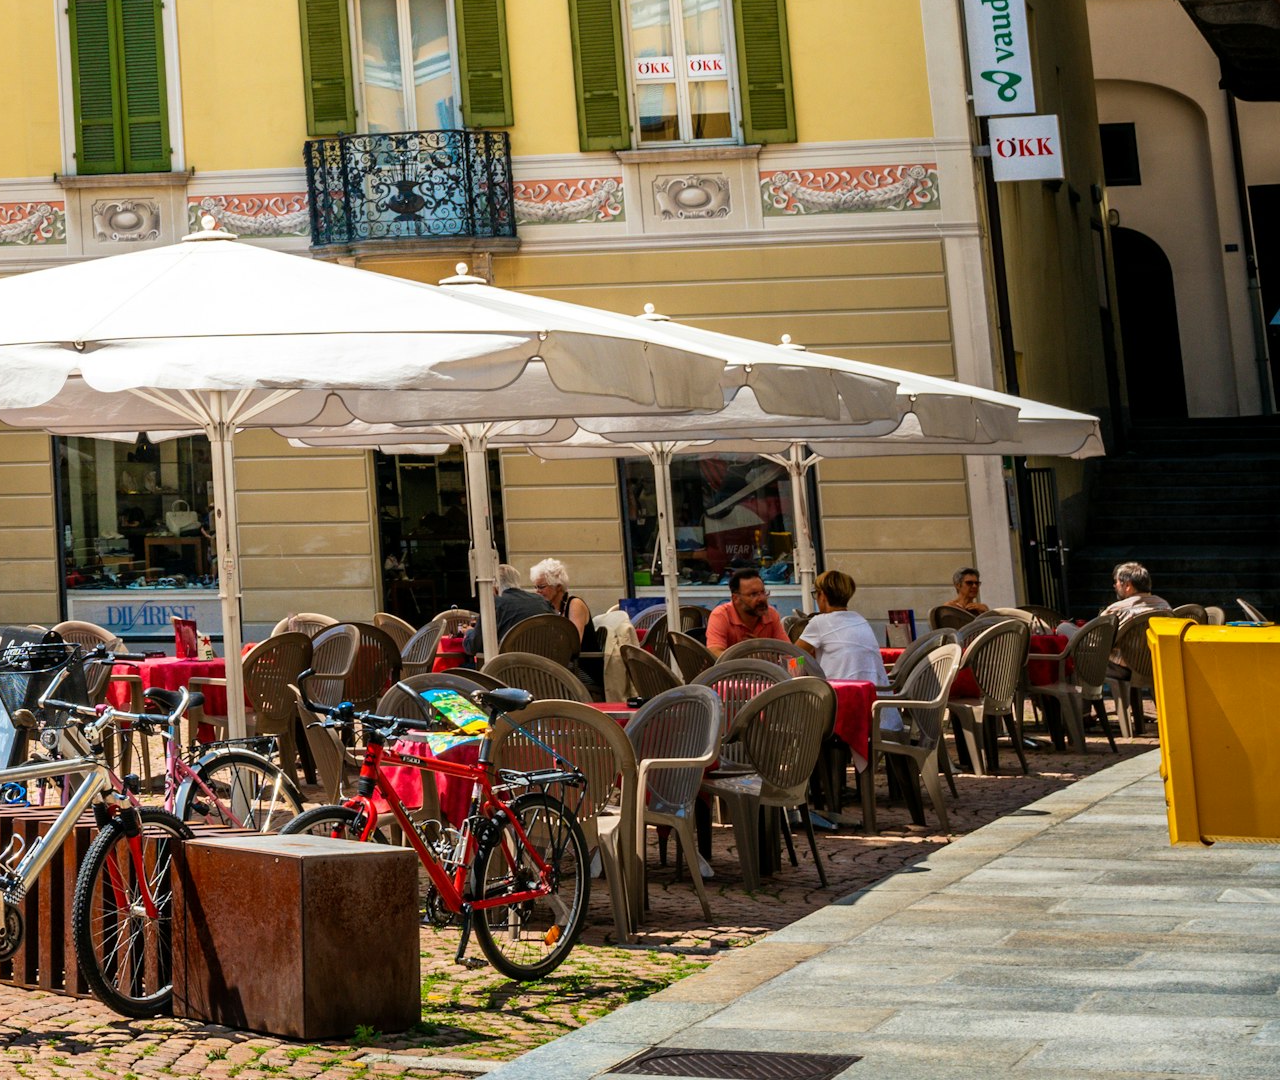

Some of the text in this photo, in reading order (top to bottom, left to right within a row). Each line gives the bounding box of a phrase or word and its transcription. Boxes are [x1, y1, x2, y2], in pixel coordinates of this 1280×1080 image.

[637, 62, 670, 75] ÖKK
[690, 59, 723, 72] ÖKK
[996, 137, 1054, 158] ÖKK
